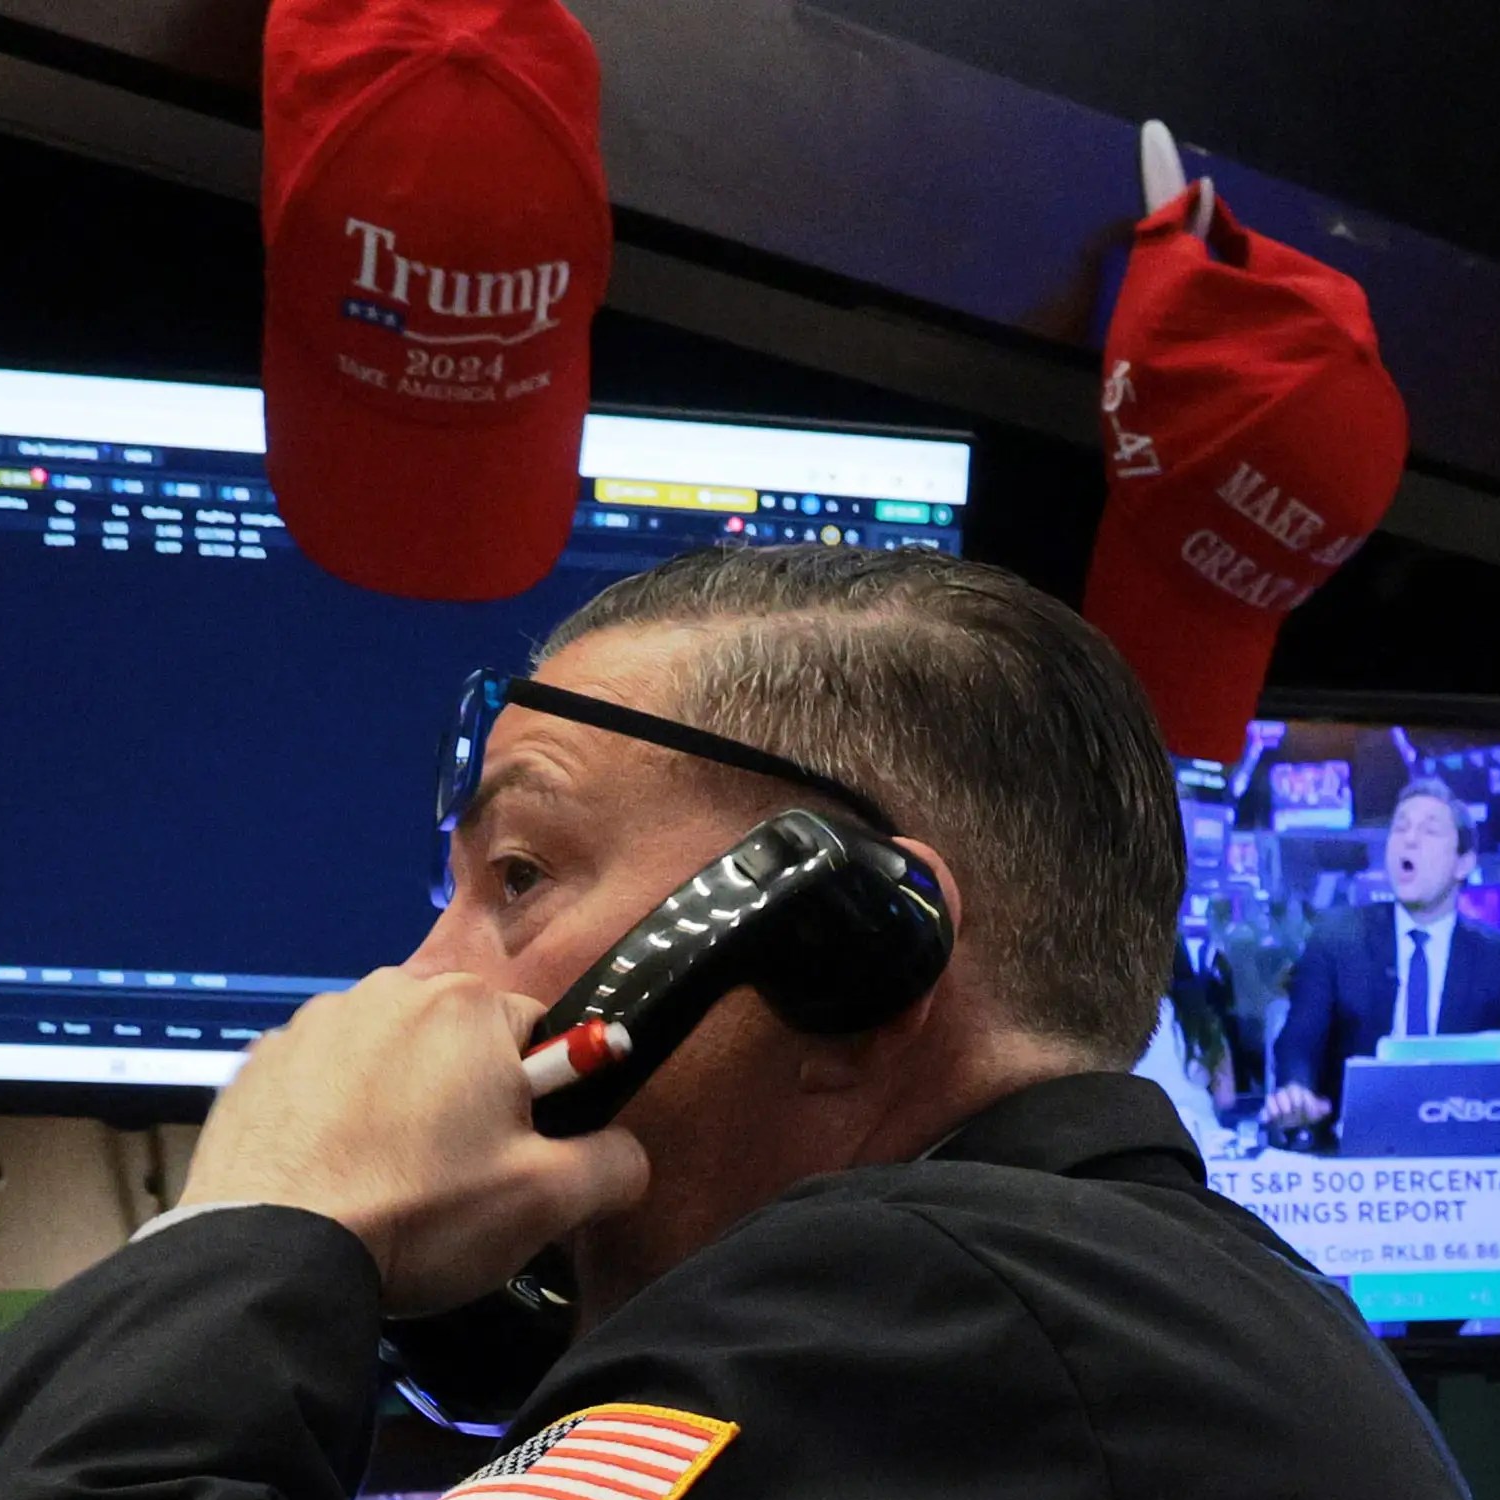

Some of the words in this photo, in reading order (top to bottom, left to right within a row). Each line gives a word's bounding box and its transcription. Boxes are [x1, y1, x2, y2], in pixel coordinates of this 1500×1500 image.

[345, 216, 571, 330] Trump
[338, 354, 388, 390] TAKE
[398, 379, 498, 402] AMERICA
[406, 348, 504, 383] 2024
[1216, 462, 1326, 551] MAKE
[1208, 1174, 1238, 1194] ST
[1251, 1172, 1302, 1193] S&P
[1313, 1170, 1365, 1191] 500
[1358, 1200, 1468, 1223] REPORT
